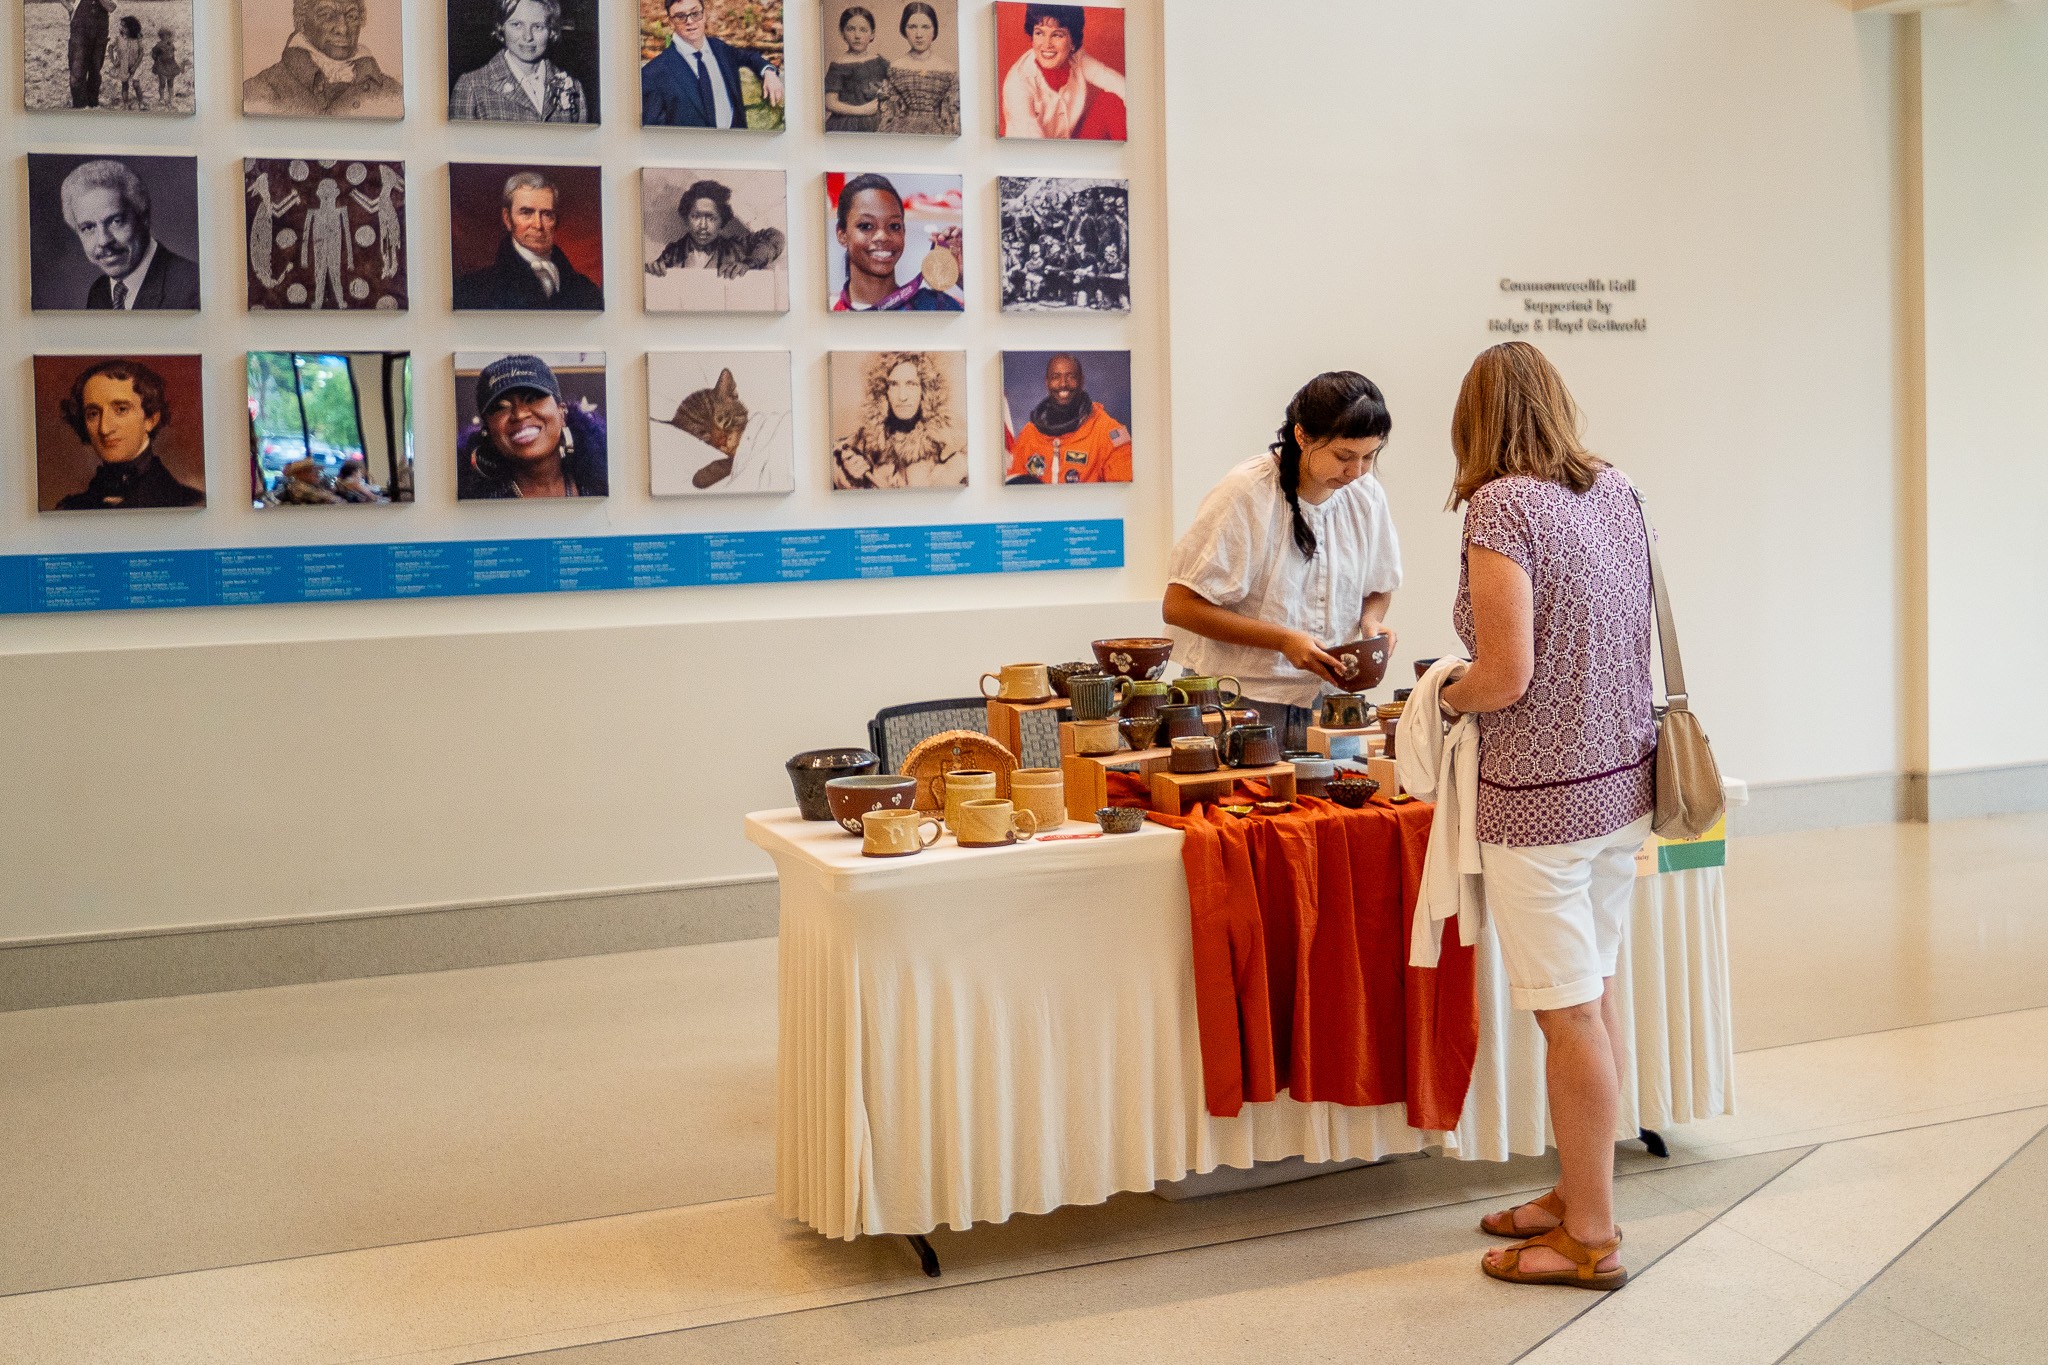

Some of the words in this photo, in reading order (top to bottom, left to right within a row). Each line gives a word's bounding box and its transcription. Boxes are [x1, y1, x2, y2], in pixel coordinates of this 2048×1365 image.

[1500, 278, 1605, 292] Commonwealth
[1609, 279, 1636, 292] Hall
[1524, 298, 1592, 314] Supported
[1596, 299, 1612, 315] by
[1533, 318, 1543, 332] &
[1548, 318, 1583, 334] Floyd
